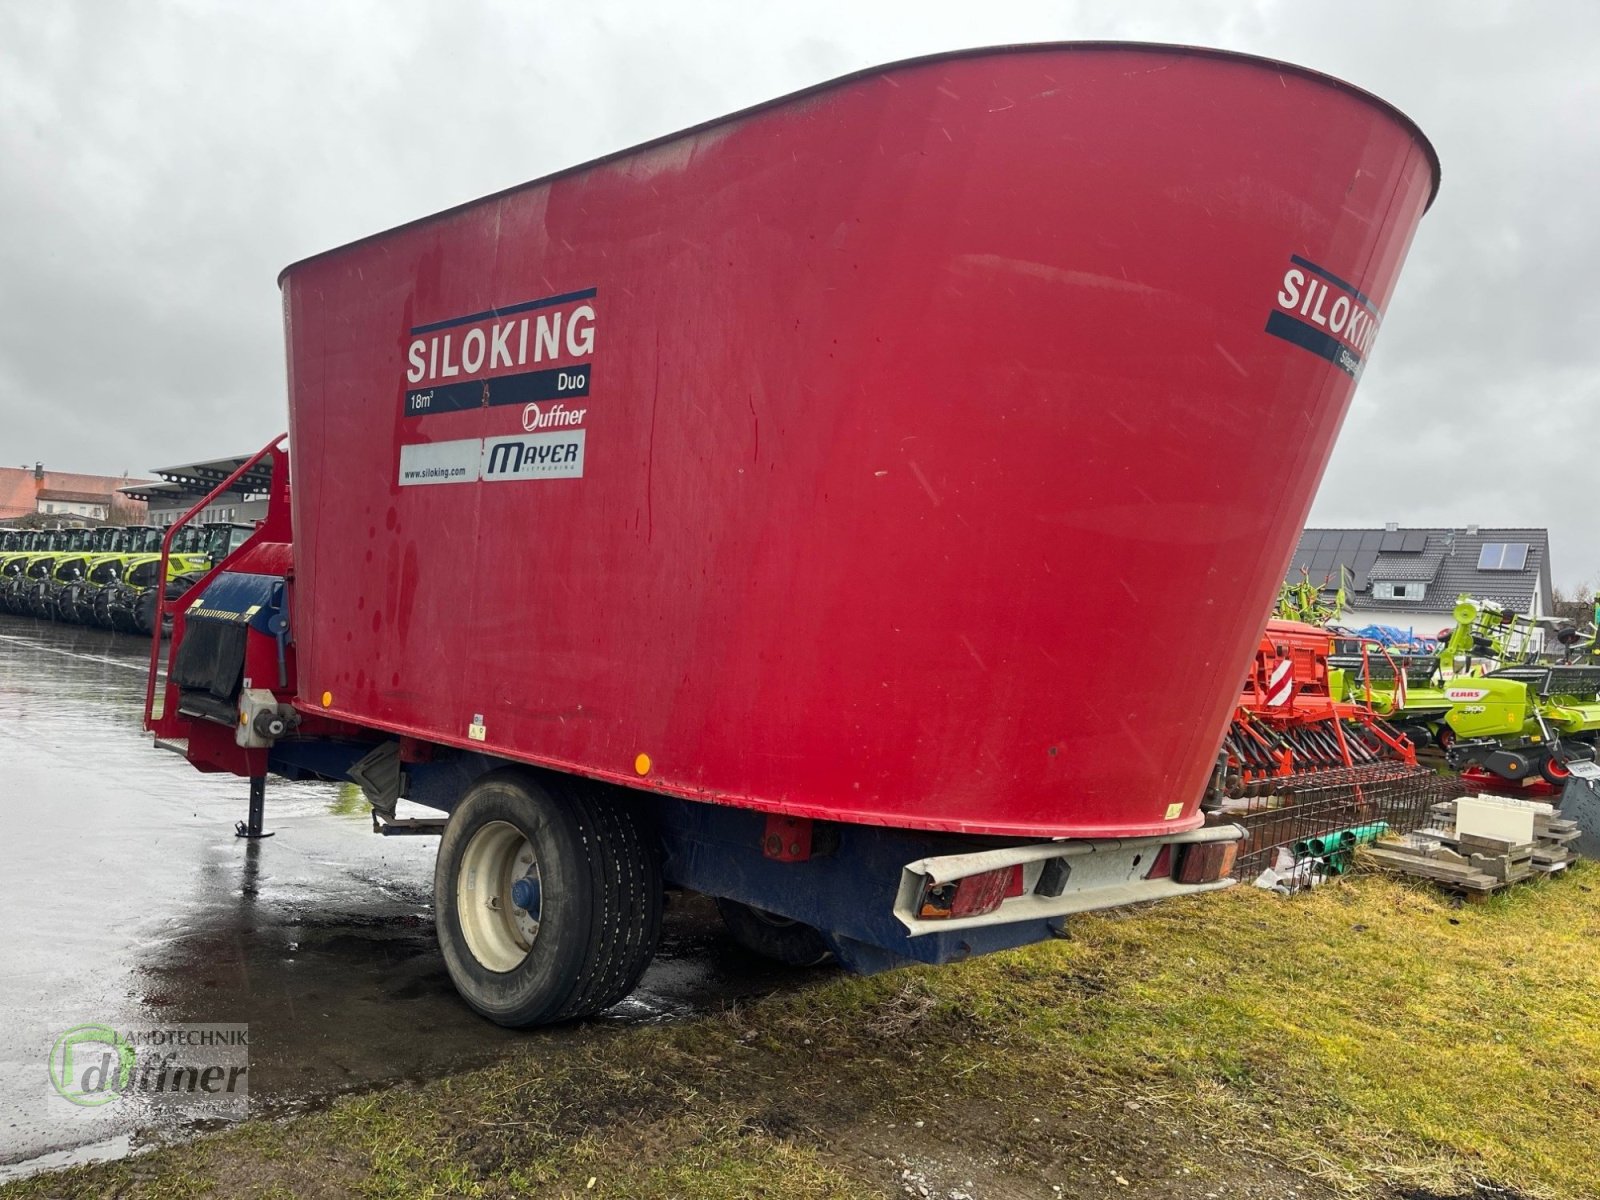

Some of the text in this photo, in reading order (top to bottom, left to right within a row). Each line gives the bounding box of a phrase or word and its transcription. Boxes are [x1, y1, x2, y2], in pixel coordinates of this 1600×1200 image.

[406, 305, 597, 384] SILOKING
[557, 373, 585, 391] Duo
[487, 441, 579, 474] MAYER
[404, 467, 466, 479] www.siloking.com
